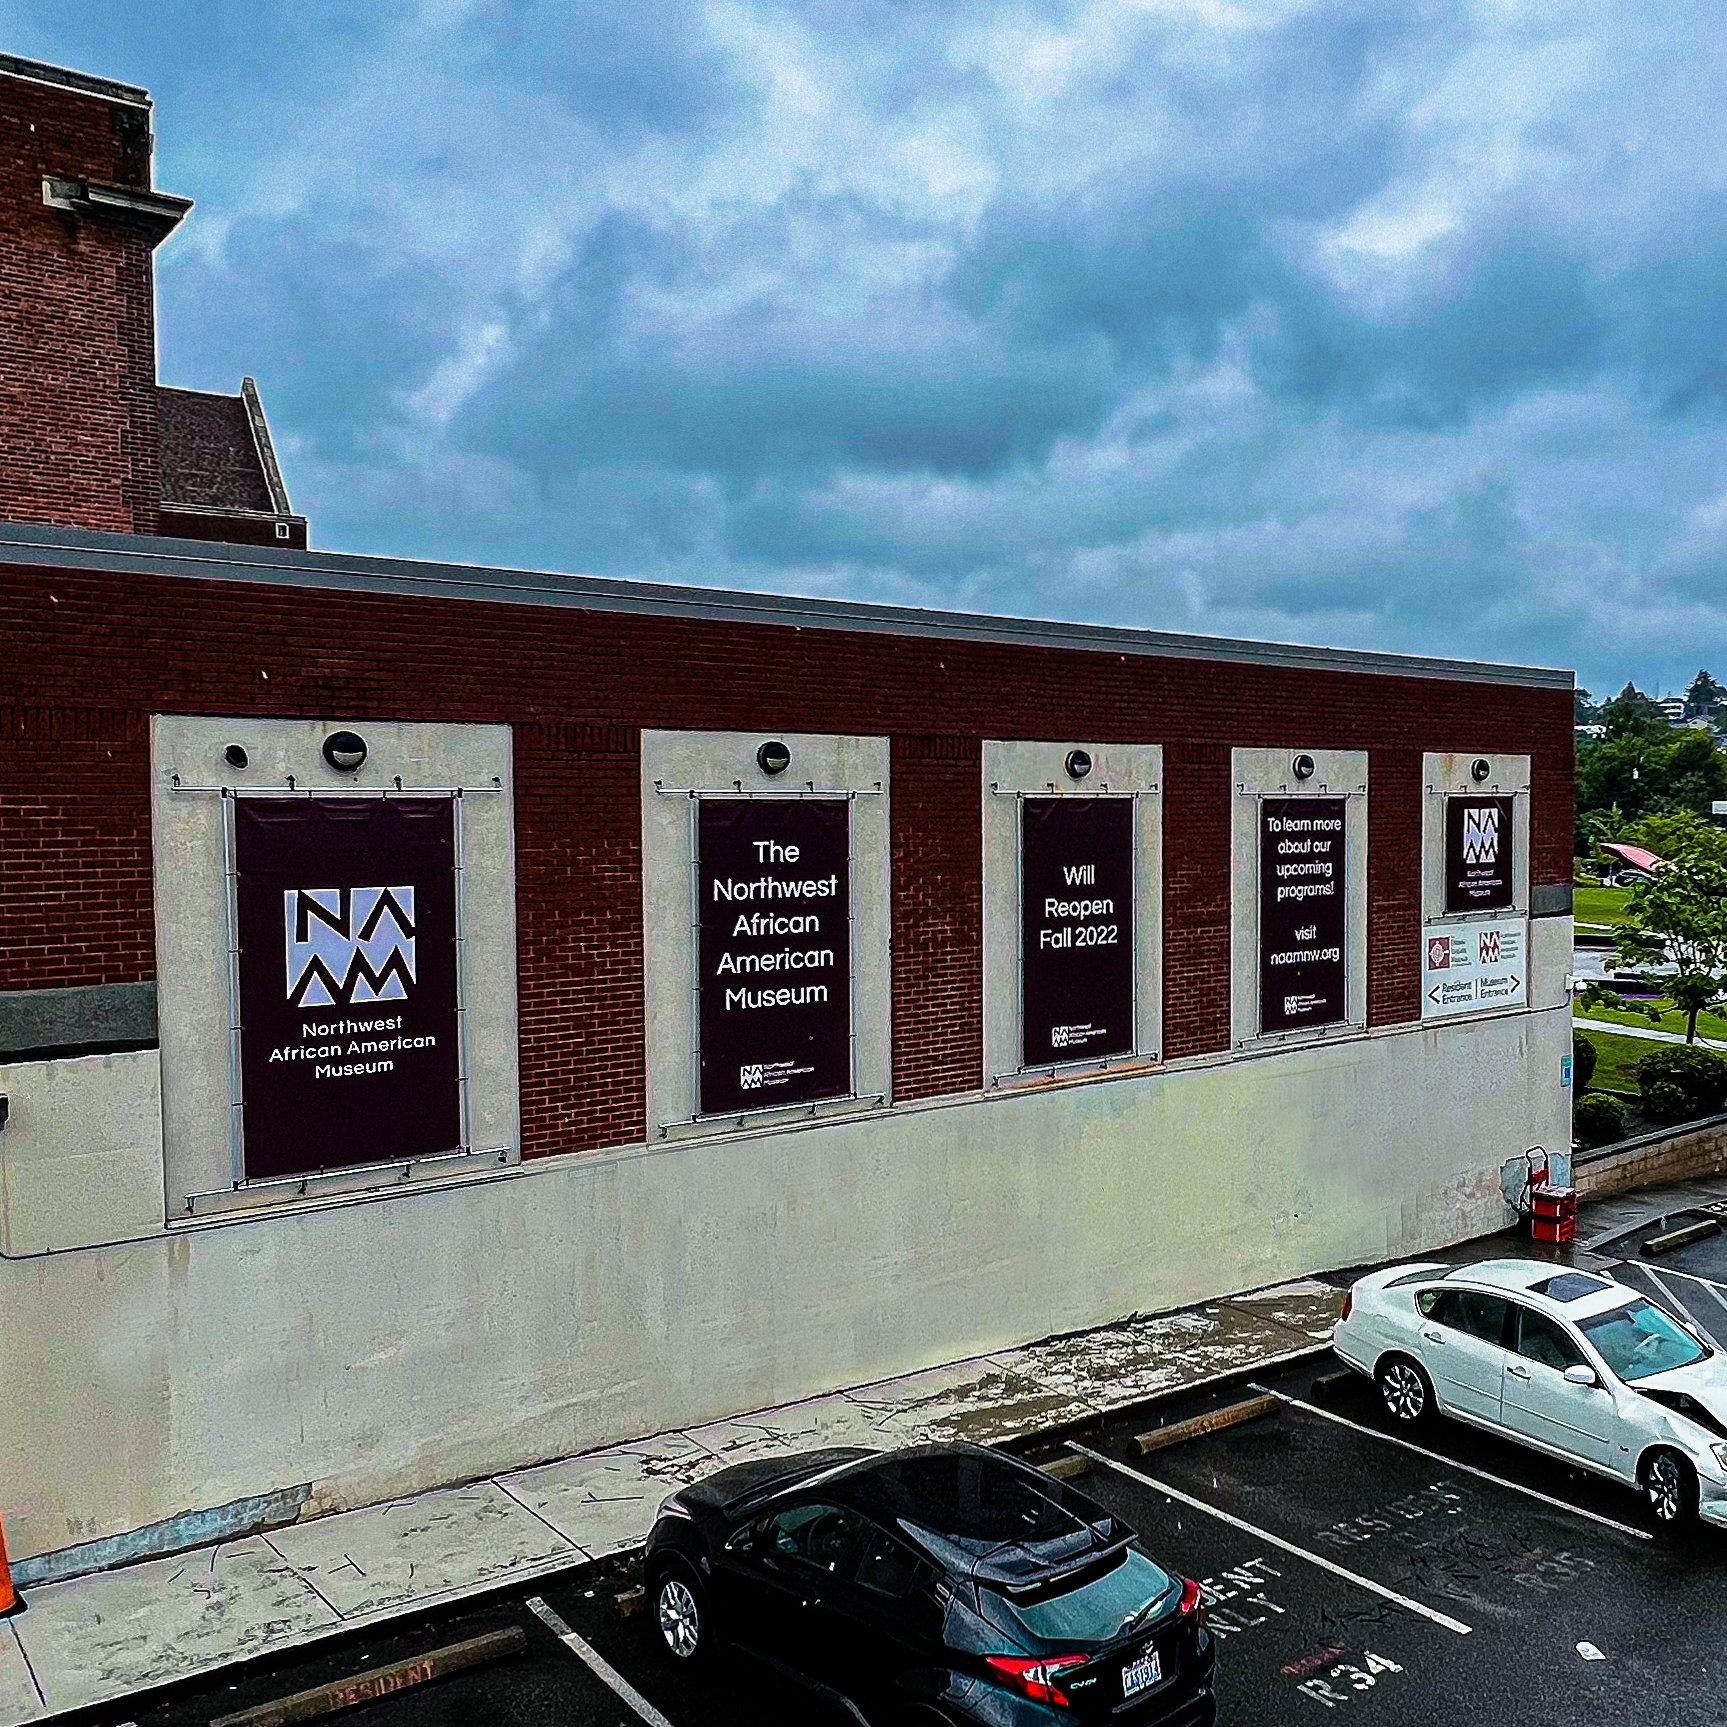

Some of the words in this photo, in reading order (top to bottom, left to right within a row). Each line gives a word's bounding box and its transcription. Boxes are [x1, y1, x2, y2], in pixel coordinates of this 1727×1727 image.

[1267, 816, 1282, 833] To
[1282, 816, 1312, 833] learn
[1312, 818, 1342, 832] more
[753, 839, 800, 864] The
[1277, 838, 1312, 855] about
[1312, 840, 1332, 854] our
[1063, 864, 1096, 886] Will
[1276, 859, 1333, 880] upcoming
[713, 874, 839, 902] Northwest
[1277, 880, 1335, 902] programs!
[1045, 897, 1114, 921] Reopen
[732, 912, 820, 937] African
[1295, 924, 1317, 942] visit
[1040, 927, 1072, 950] Fall
[1075, 924, 1118, 947] 2022
[716, 947, 834, 976] American
[1270, 947, 1340, 965] naamnw.org
[725, 985, 828, 1011] Museum
[1480, 988, 1508, 999] Entrance
[302, 1014, 403, 1038] Northwest
[268, 1043, 341, 1063] African
[346, 1034, 436, 1055] American
[315, 1057, 394, 1079] Museum
